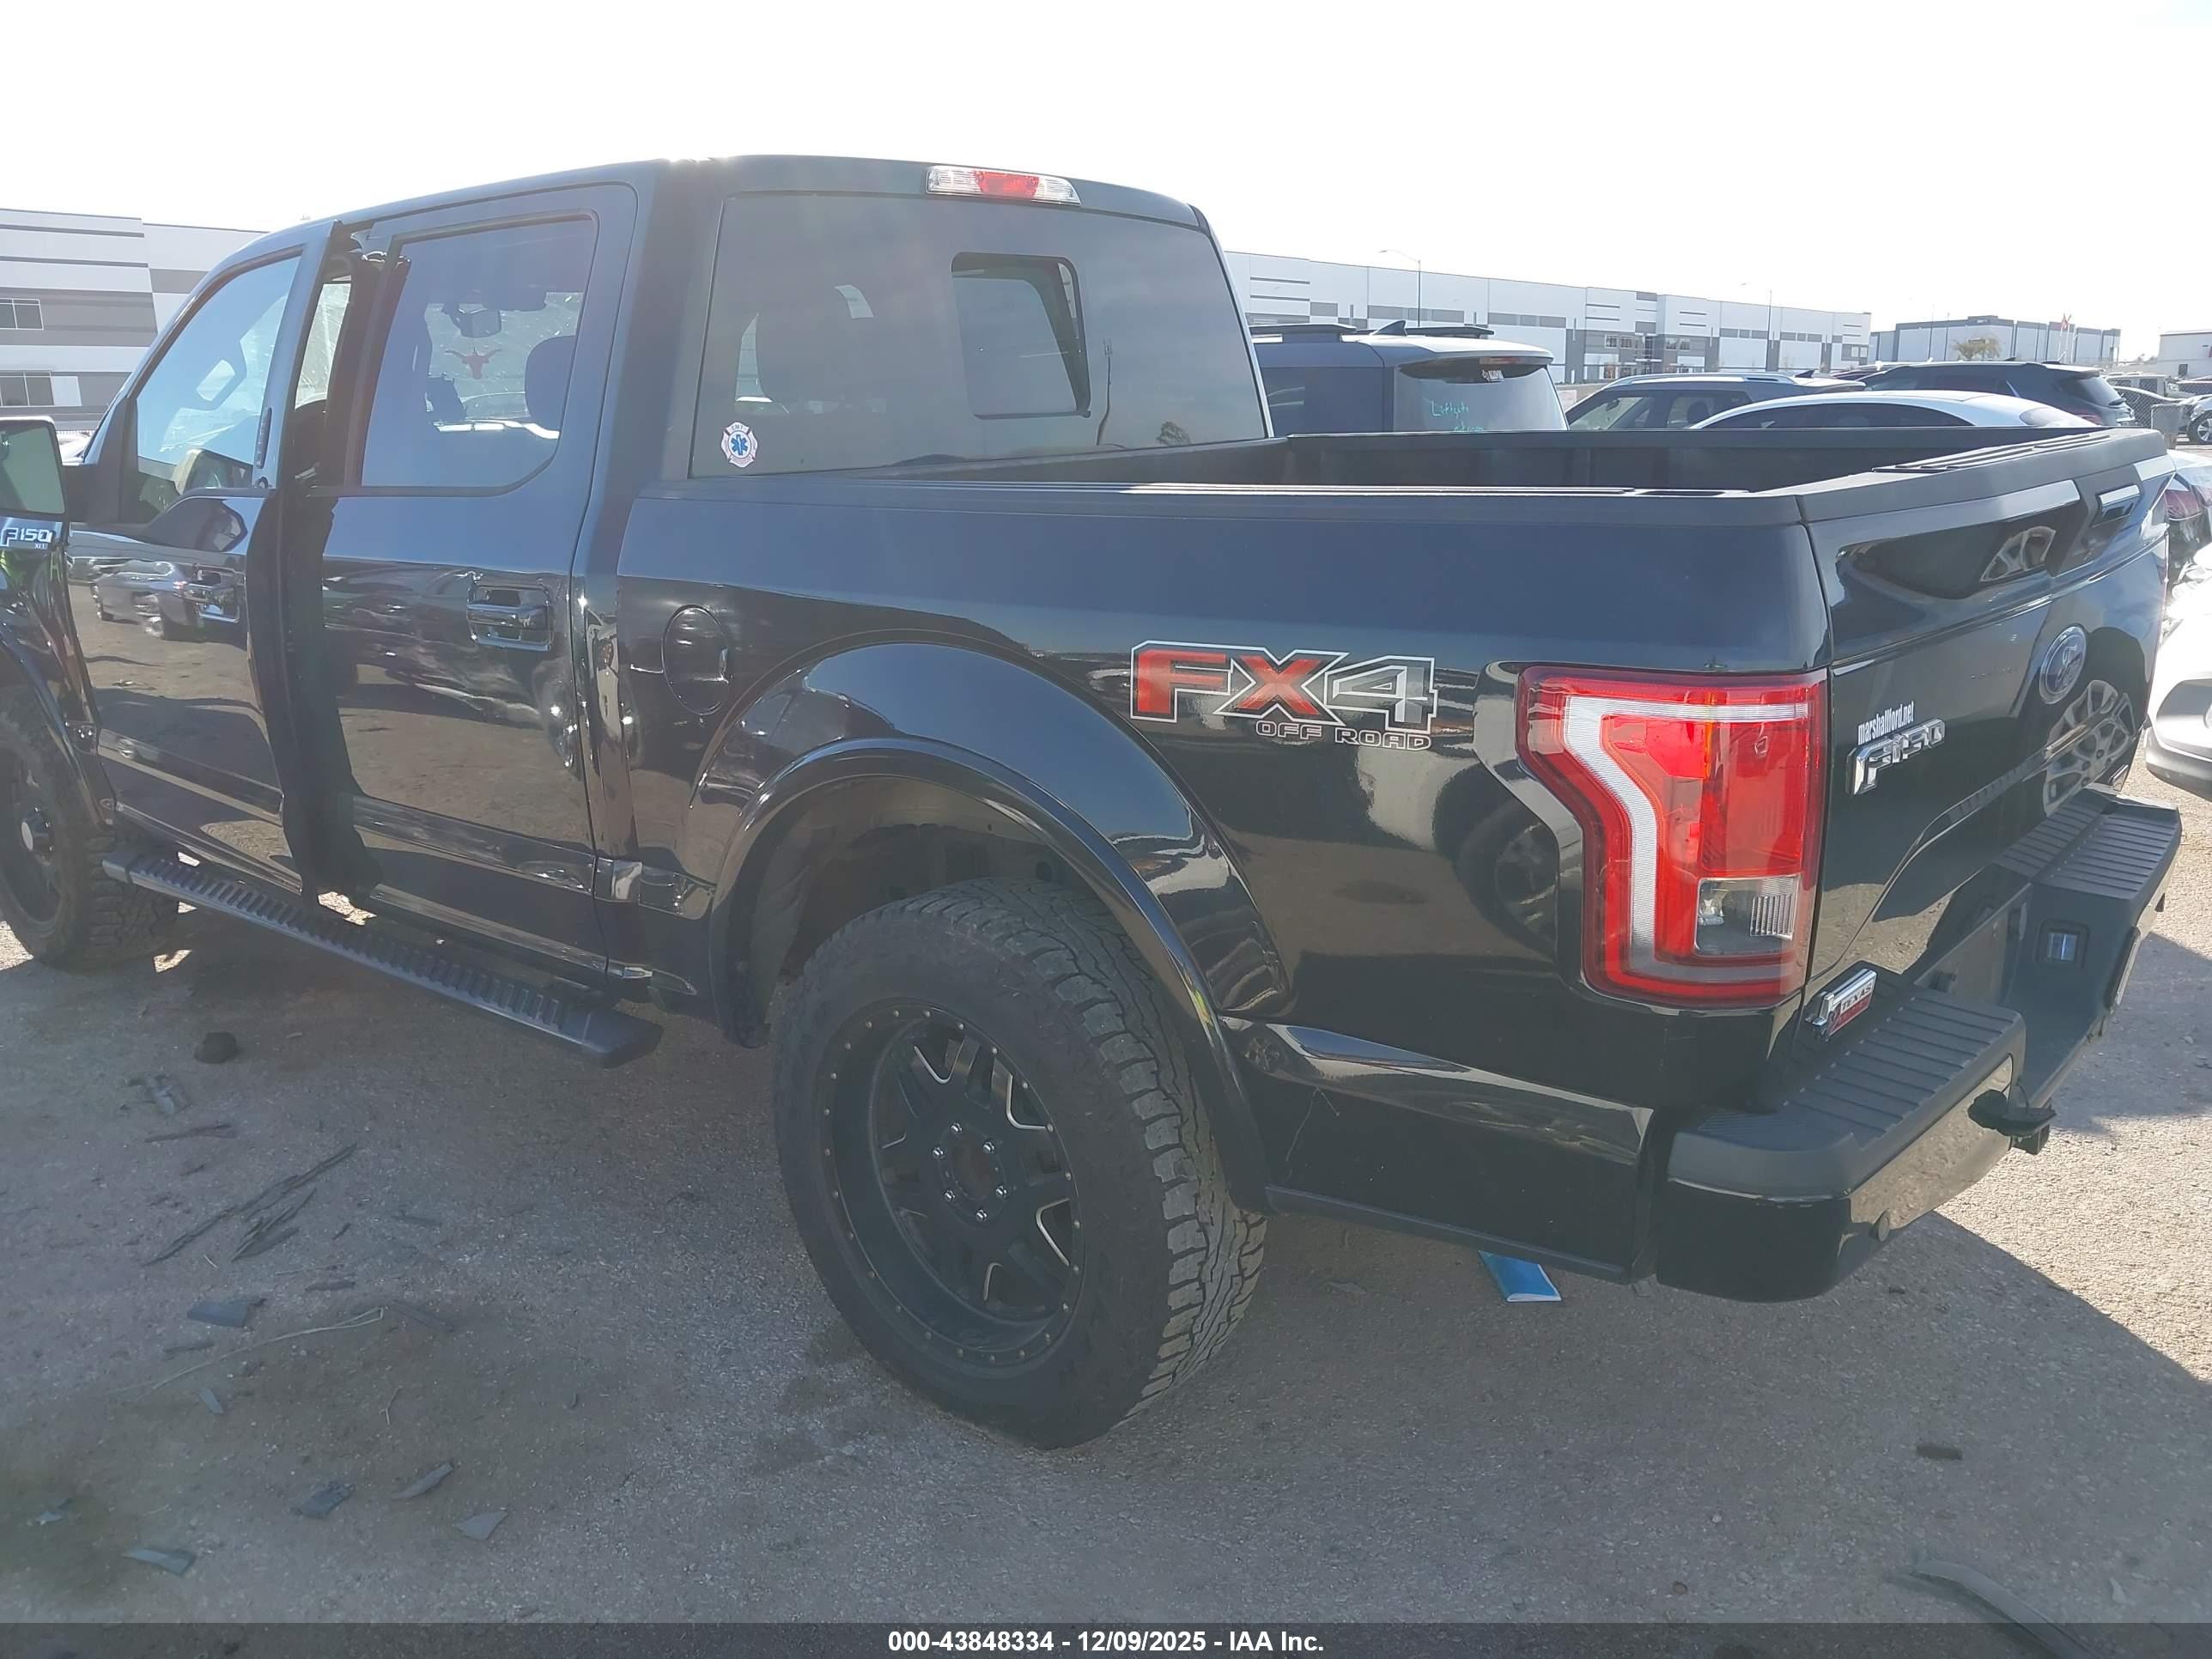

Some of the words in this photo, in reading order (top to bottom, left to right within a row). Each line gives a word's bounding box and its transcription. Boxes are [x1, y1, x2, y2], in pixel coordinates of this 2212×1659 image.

[1131, 640, 1437, 733] FX4
[1256, 720, 1322, 740] OFF
[1334, 726, 1431, 751] ROAD
[1857, 700, 1914, 746] marshallford.net
[1842, 981, 1872, 1012] TEXAS
